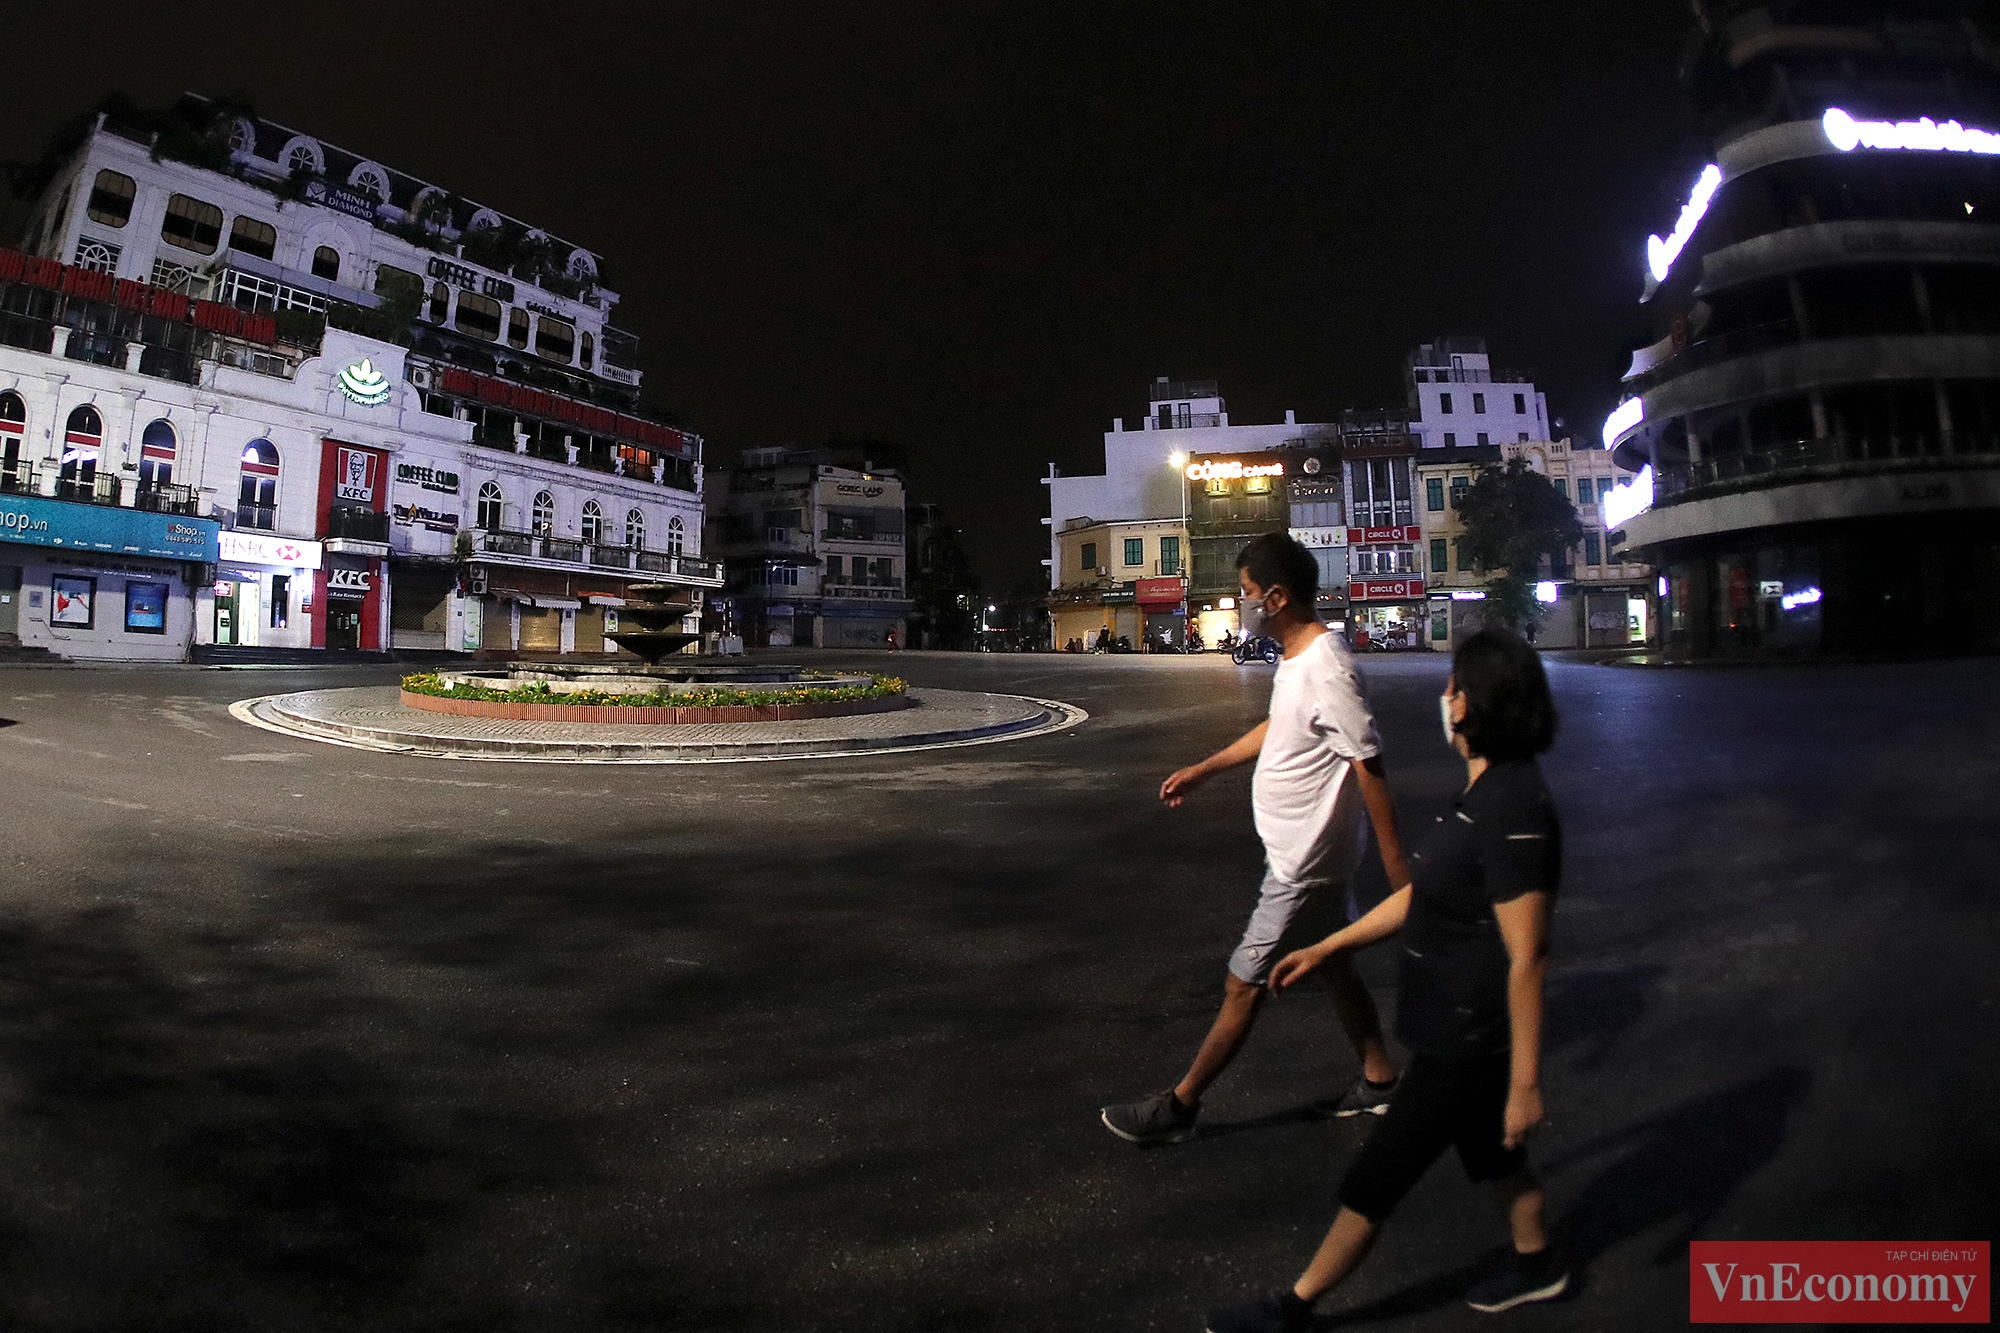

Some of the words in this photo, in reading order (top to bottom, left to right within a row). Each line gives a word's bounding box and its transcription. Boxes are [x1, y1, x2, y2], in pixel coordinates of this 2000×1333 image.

[328, 197, 373, 219] DIAMOND
[335, 189, 371, 209] MINH
[427, 256, 478, 291] COFFEE
[337, 382, 390, 405] PHYTOPHARCO
[398, 463, 434, 482] COFFEE
[342, 487, 368, 500] KFC
[837, 484, 861, 493] GOTEC
[862, 486, 884, 494] LAND
[1368, 531, 1390, 539] CIRCLE
[1391, 529, 1401, 539] K
[224, 537, 268, 559] HSBC
[331, 568, 371, 587] KFC
[1370, 585, 1393, 593] CIRCLE
[1394, 583, 1404, 594] K
